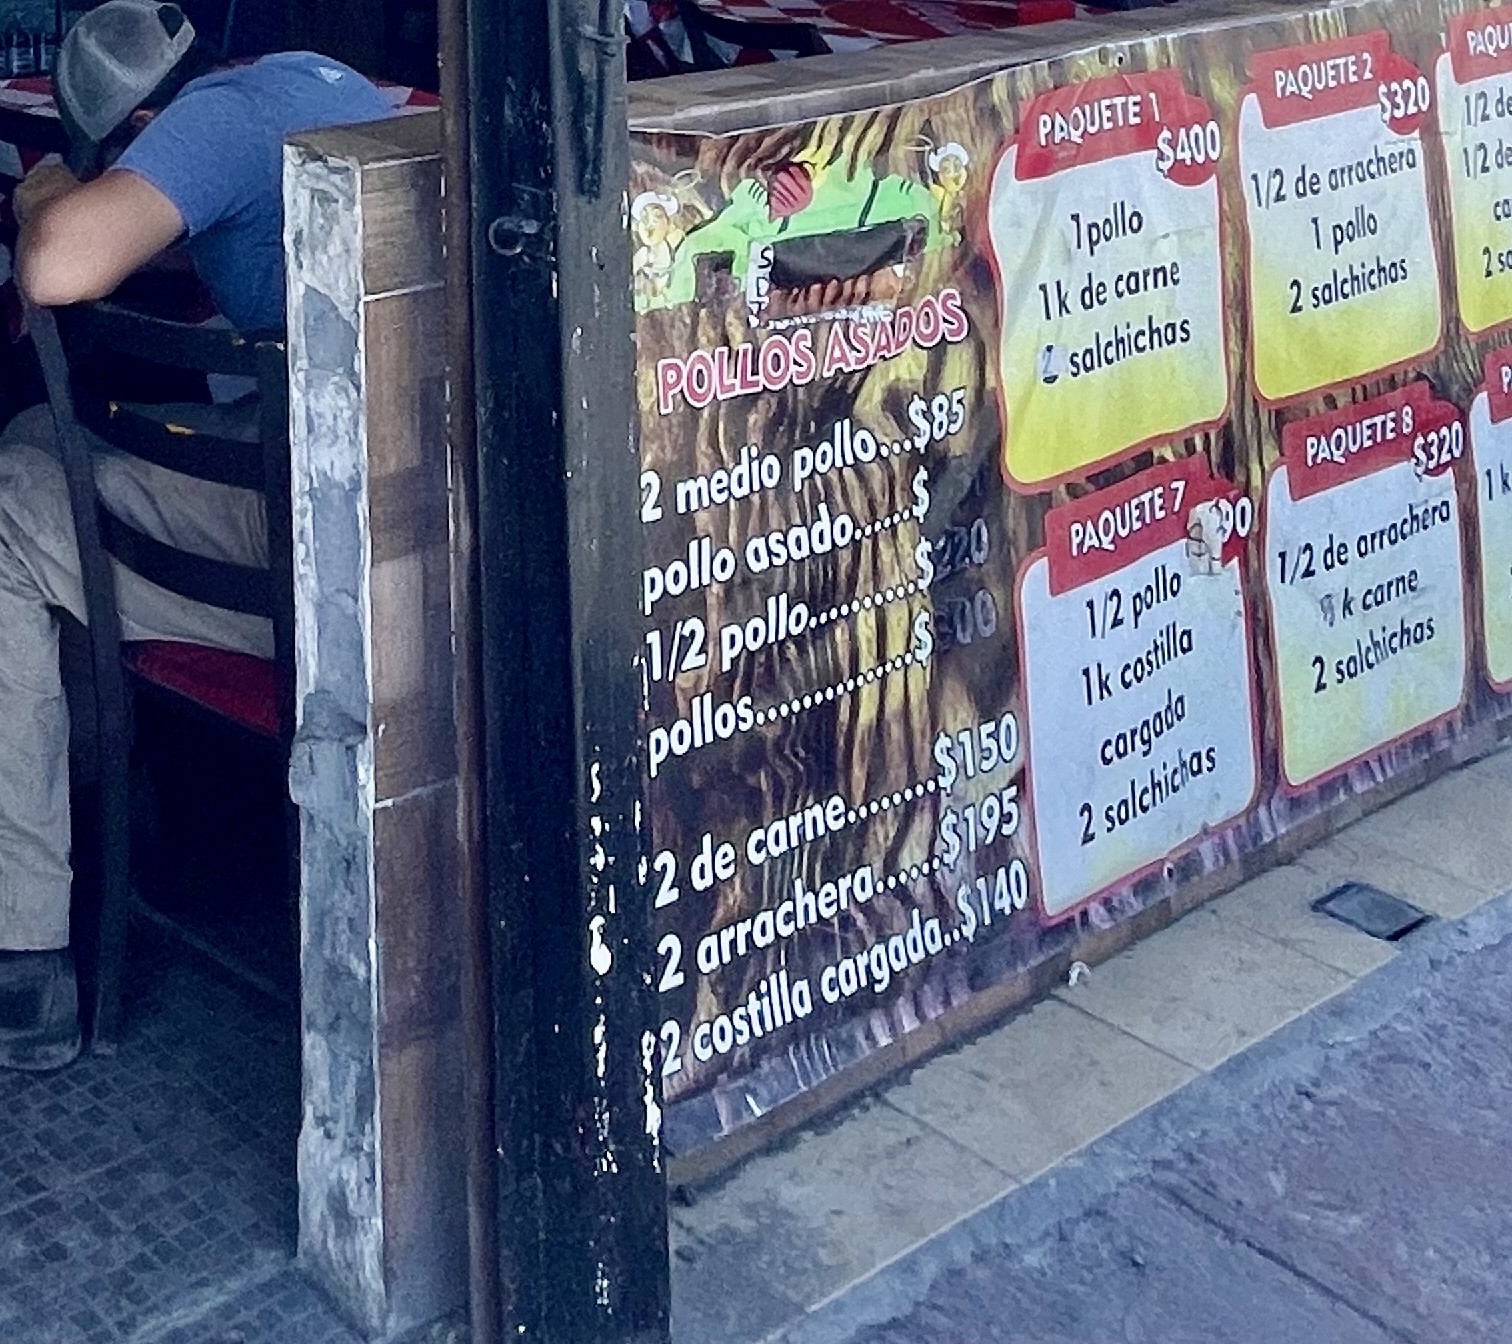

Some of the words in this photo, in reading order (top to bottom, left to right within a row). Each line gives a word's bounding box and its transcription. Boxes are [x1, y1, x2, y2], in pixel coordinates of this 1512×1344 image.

[1273, 54, 1359, 100] PAQUETE
[1361, 51, 1374, 81] 2
[1377, 76, 1431, 124] $320
[1464, 90, 1489, 128] 1/2
[1036, 94, 1144, 147] PAQUETE
[1148, 92, 1162, 123] 1
[1155, 119, 1222, 180] $400
[1462, 141, 1489, 180] 1/2
[1250, 171, 1288, 211] 1/2
[1293, 163, 1323, 202] de
[1327, 142, 1418, 191] arrachera
[1310, 215, 1323, 250] 1
[1331, 205, 1379, 256] pollo
[1481, 246, 1493, 280] 2
[1080, 271, 1108, 312] de
[1113, 258, 1181, 299] carne
[1288, 278, 1304, 315] 2
[1310, 254, 1409, 309] salchichas
[657, 327, 818, 415] POLLOS
[823, 287, 969, 378] ASADOS
[1068, 315, 1192, 380] salchichas
[1304, 416, 1397, 468] PAQUETE
[1400, 404, 1415, 437] 8
[1411, 421, 1465, 483] $320
[676, 444, 782, 514] medio
[1069, 487, 1167, 558] PAQUETE
[1171, 480, 1187, 514] 7
[1276, 541, 1316, 587] 1/2
[1321, 532, 1350, 574] de
[1356, 498, 1452, 562] arrachera
[642, 536, 736, 615] pollo
[1085, 588, 1125, 640] 1/2
[1132, 564, 1183, 626] pollo
[1341, 586, 1356, 620] k
[1361, 567, 1420, 612] carne
[644, 616, 708, 683] 1/2
[1120, 624, 1194, 690] costilla
[1312, 653, 1328, 695] 2
[1334, 614, 1437, 686] salchichas
[1099, 690, 1187, 767] cargada
[1078, 801, 1097, 846] 2
[1104, 744, 1217, 835] salchichas
[690, 834, 737, 891] de
[691, 963, 813, 1063] costilla
